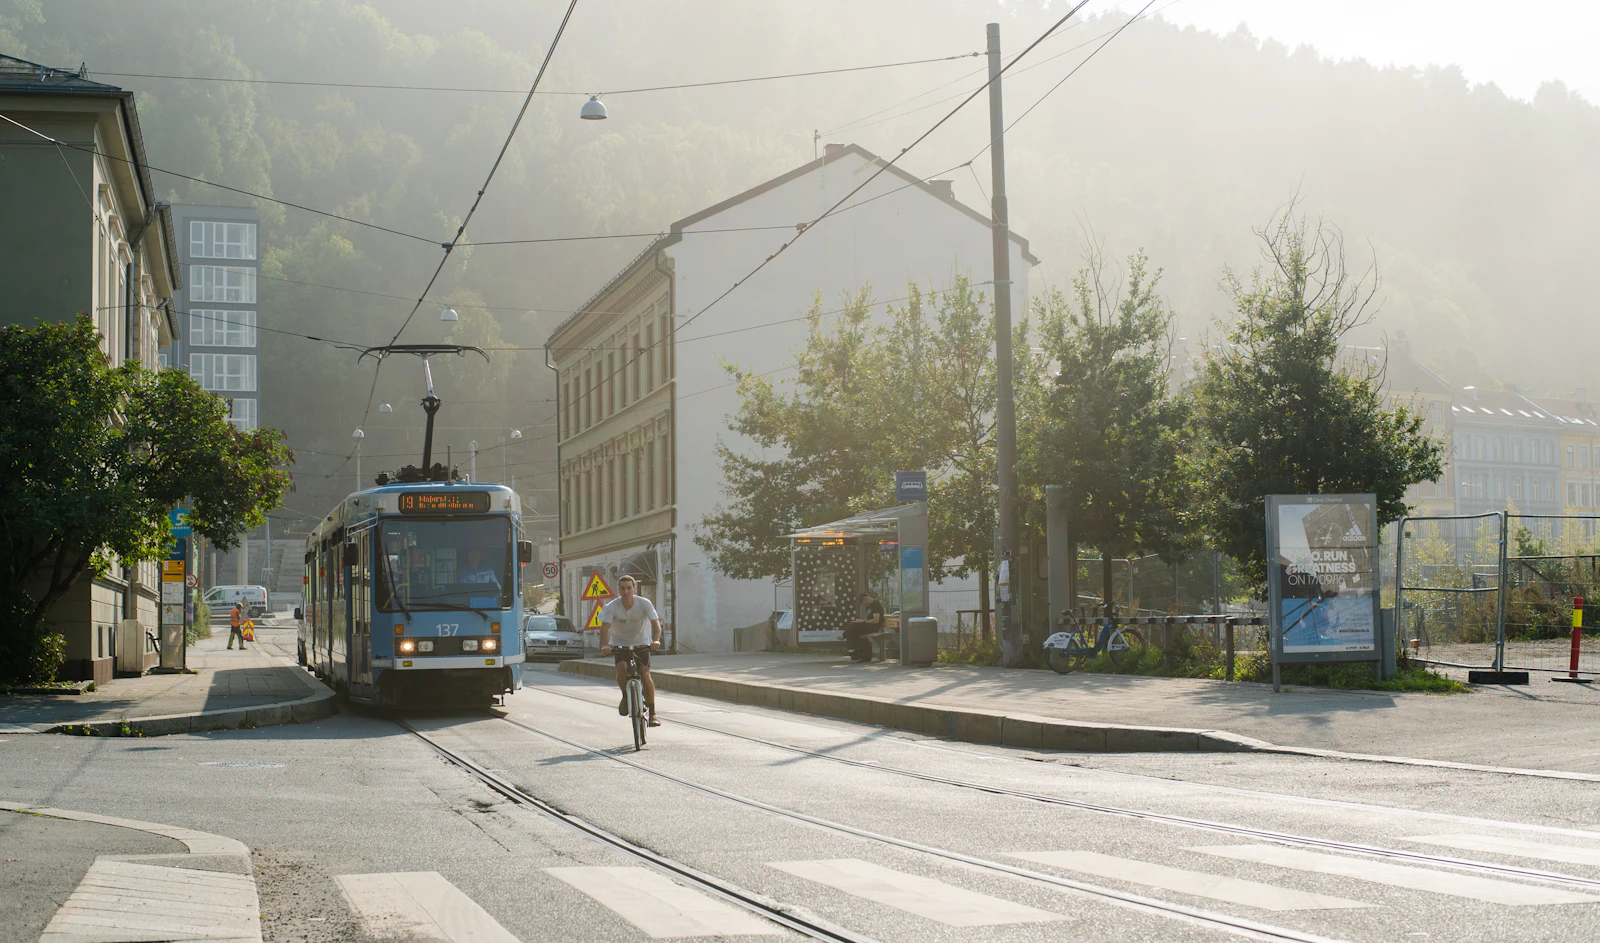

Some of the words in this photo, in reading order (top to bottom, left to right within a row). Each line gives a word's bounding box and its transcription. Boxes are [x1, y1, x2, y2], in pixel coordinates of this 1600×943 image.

[175, 513, 185, 526] 5
[1342, 534, 1367, 542] adidas
[545, 567, 556, 575] 50
[1289, 562, 1356, 573] GREATNESS
[1287, 574, 1306, 586] ON
[436, 623, 460, 637] 137
